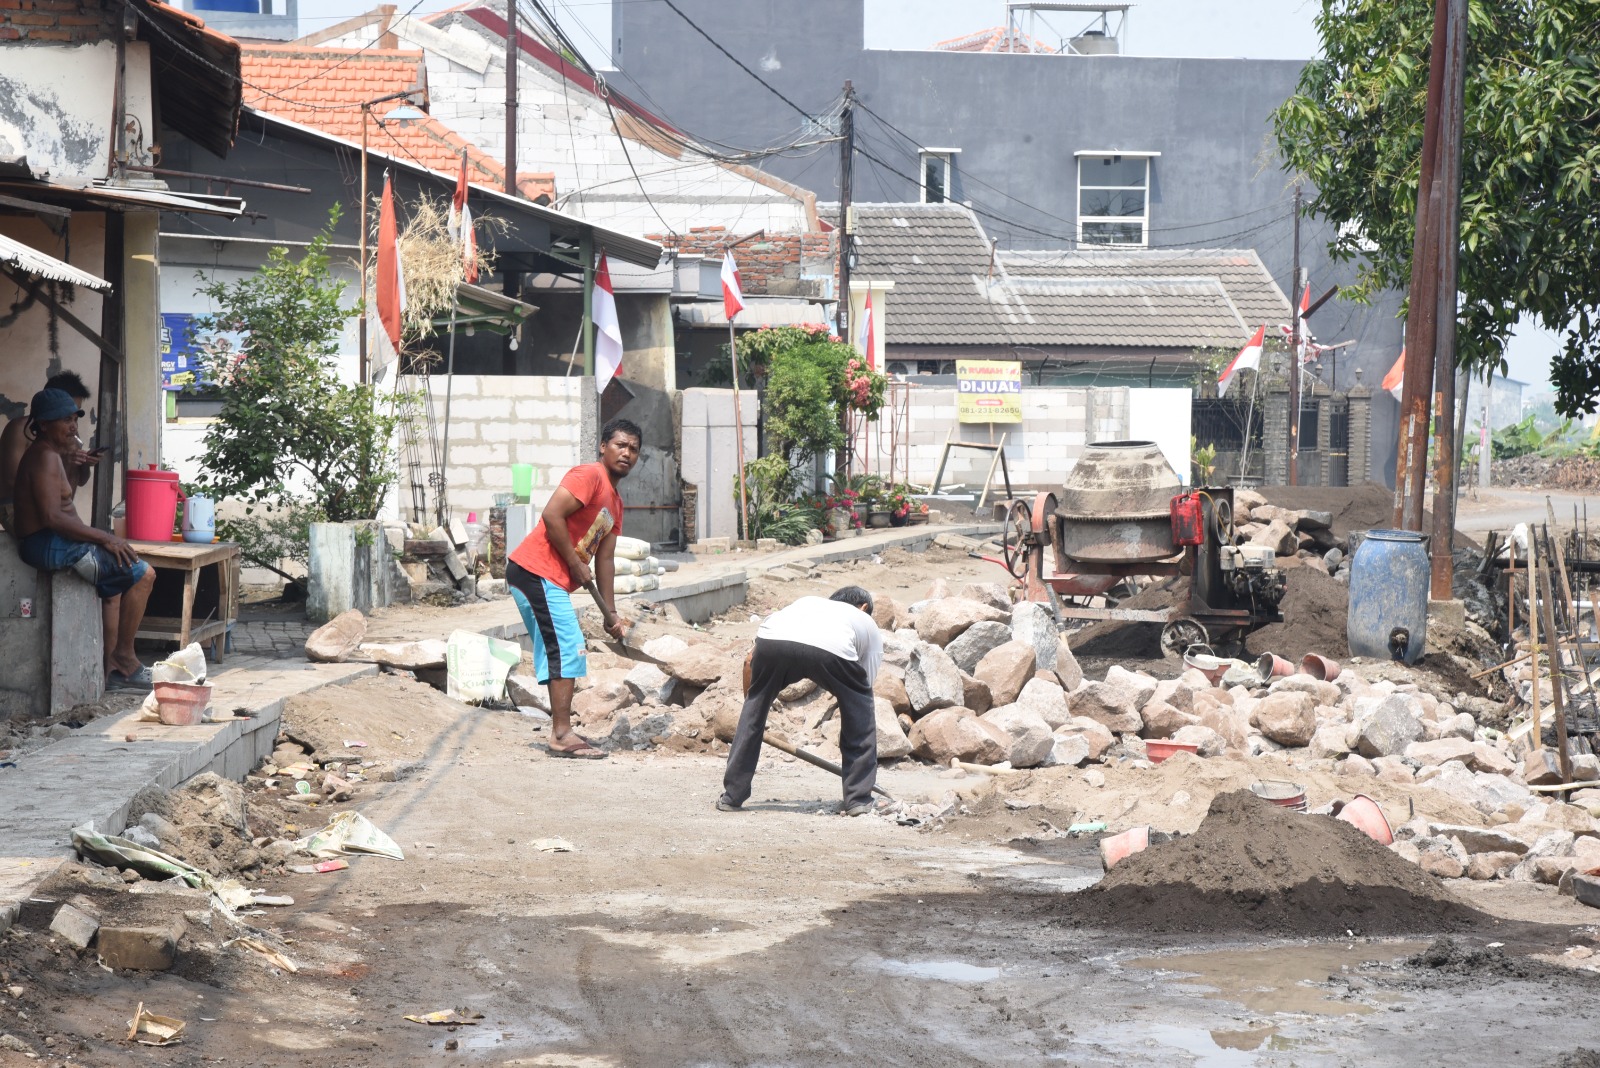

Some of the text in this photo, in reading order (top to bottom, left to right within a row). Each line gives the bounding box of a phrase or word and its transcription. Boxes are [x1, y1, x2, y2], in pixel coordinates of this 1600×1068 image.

[968, 367, 1003, 375] RUMAH
[960, 380, 1019, 393] DIJUAL
[462, 679, 505, 689] NAMIX
